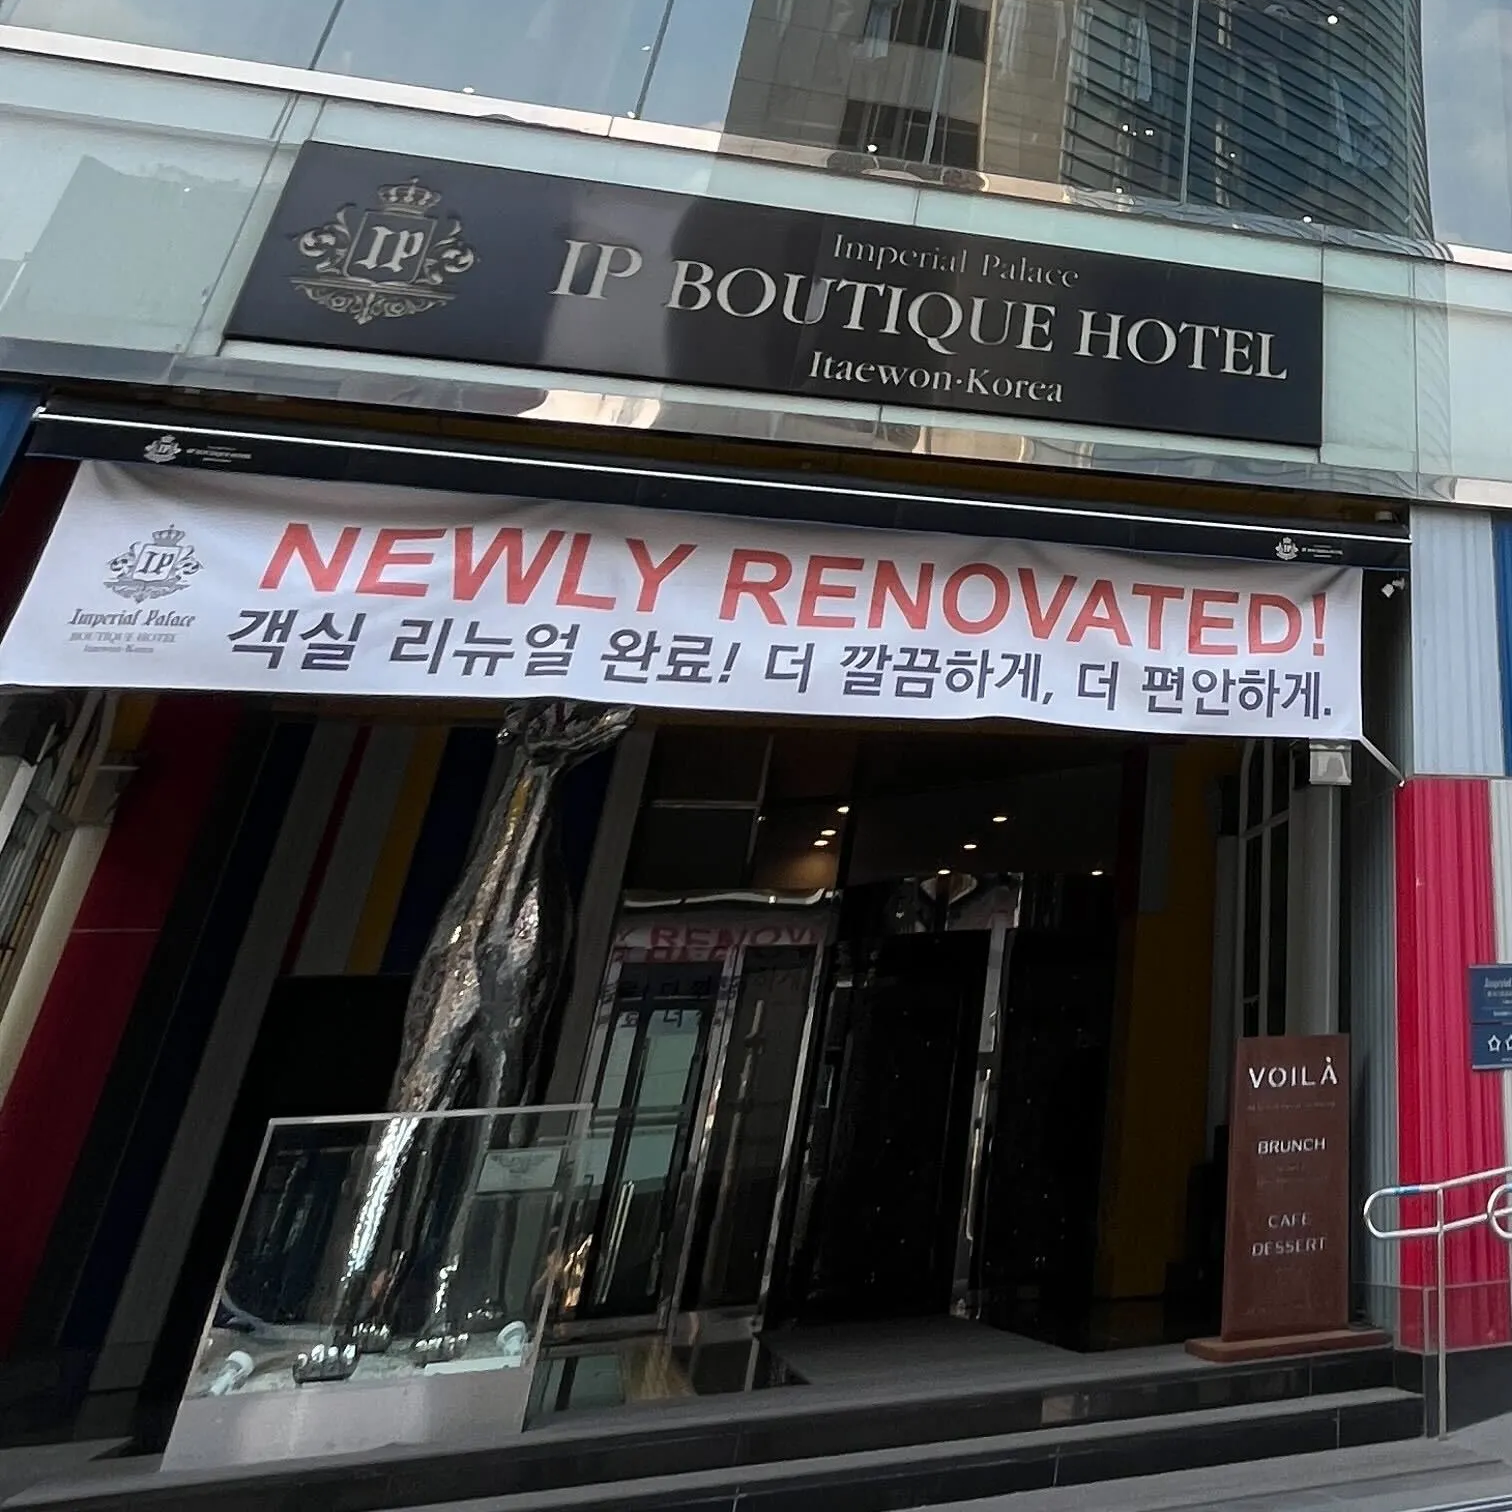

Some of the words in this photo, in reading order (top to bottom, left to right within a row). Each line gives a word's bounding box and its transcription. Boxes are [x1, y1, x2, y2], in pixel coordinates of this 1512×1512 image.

[356, 224, 425, 273] IP
[833, 233, 968, 275] Imperial
[981, 252, 1080, 289] Palace
[551, 239, 643, 300] IP
[662, 258, 1057, 357] BOUTIQUE
[1072, 308, 1288, 381] HOTEL
[258, 521, 698, 614] NEWLY
[718, 547, 1328, 659] RENOVATED!
[68, 608, 143, 628] Imperial
[142, 609, 196, 627] Palace
[226, 608, 366, 671] 객실
[389, 618, 580, 678] 리뉴얼
[599, 625, 742, 686] 완료!
[764, 643, 816, 695] 더
[839, 644, 1053, 706] 깔끔하게,
[1076, 662, 1118, 711] 더
[1140, 666, 1332, 720] 편안하게.
[1257, 1137, 1327, 1155] BRUNCH
[1251, 1236, 1328, 1257] DESSERT
